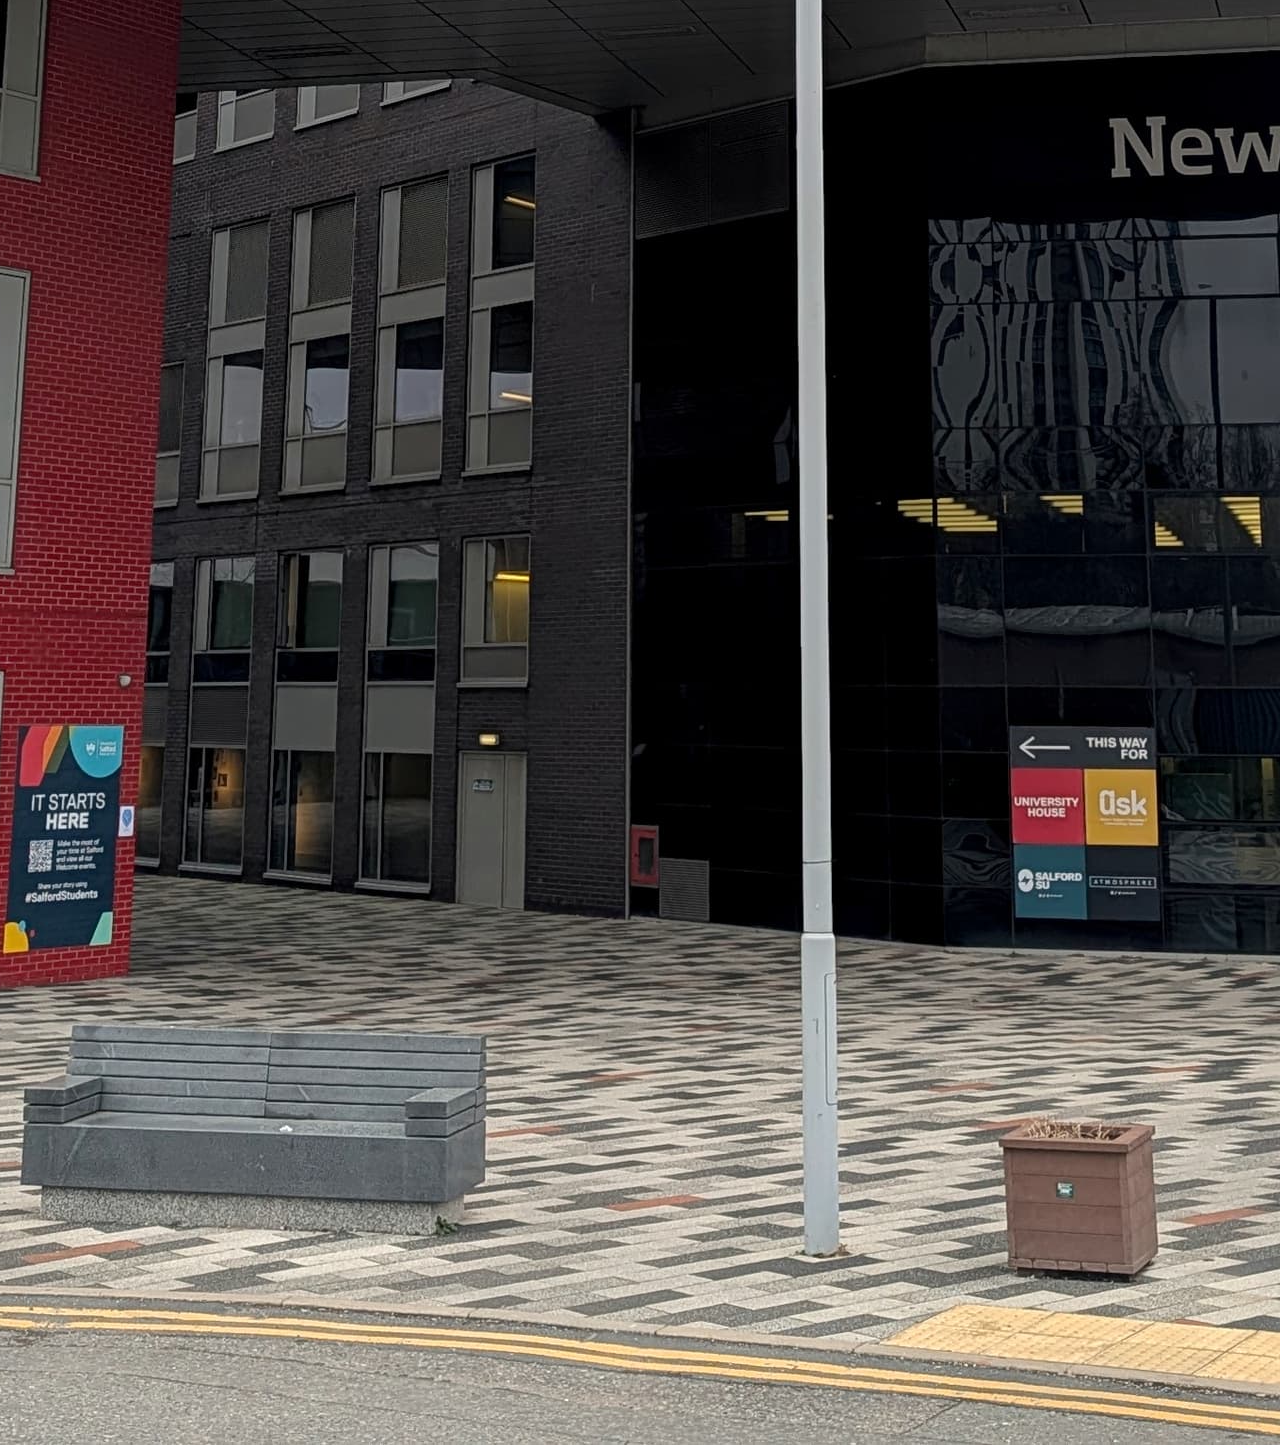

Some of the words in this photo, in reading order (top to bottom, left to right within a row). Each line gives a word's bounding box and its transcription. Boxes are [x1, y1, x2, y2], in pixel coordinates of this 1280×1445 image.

[1085, 736, 1117, 748] THIS
[1119, 737, 1148, 749] WAY
[1120, 749, 1148, 760] FOR
[31, 794, 46, 811] IT
[48, 792, 106, 810] STARTS
[1014, 796, 1079, 808] UNIVERSITY
[1027, 807, 1066, 818] HOUSE
[45, 812, 90, 830] HERE
[1035, 871, 1083, 882] SALFORD
[1035, 881, 1051, 890] SU
[25, 889, 99, 904] #SalfordStudents
